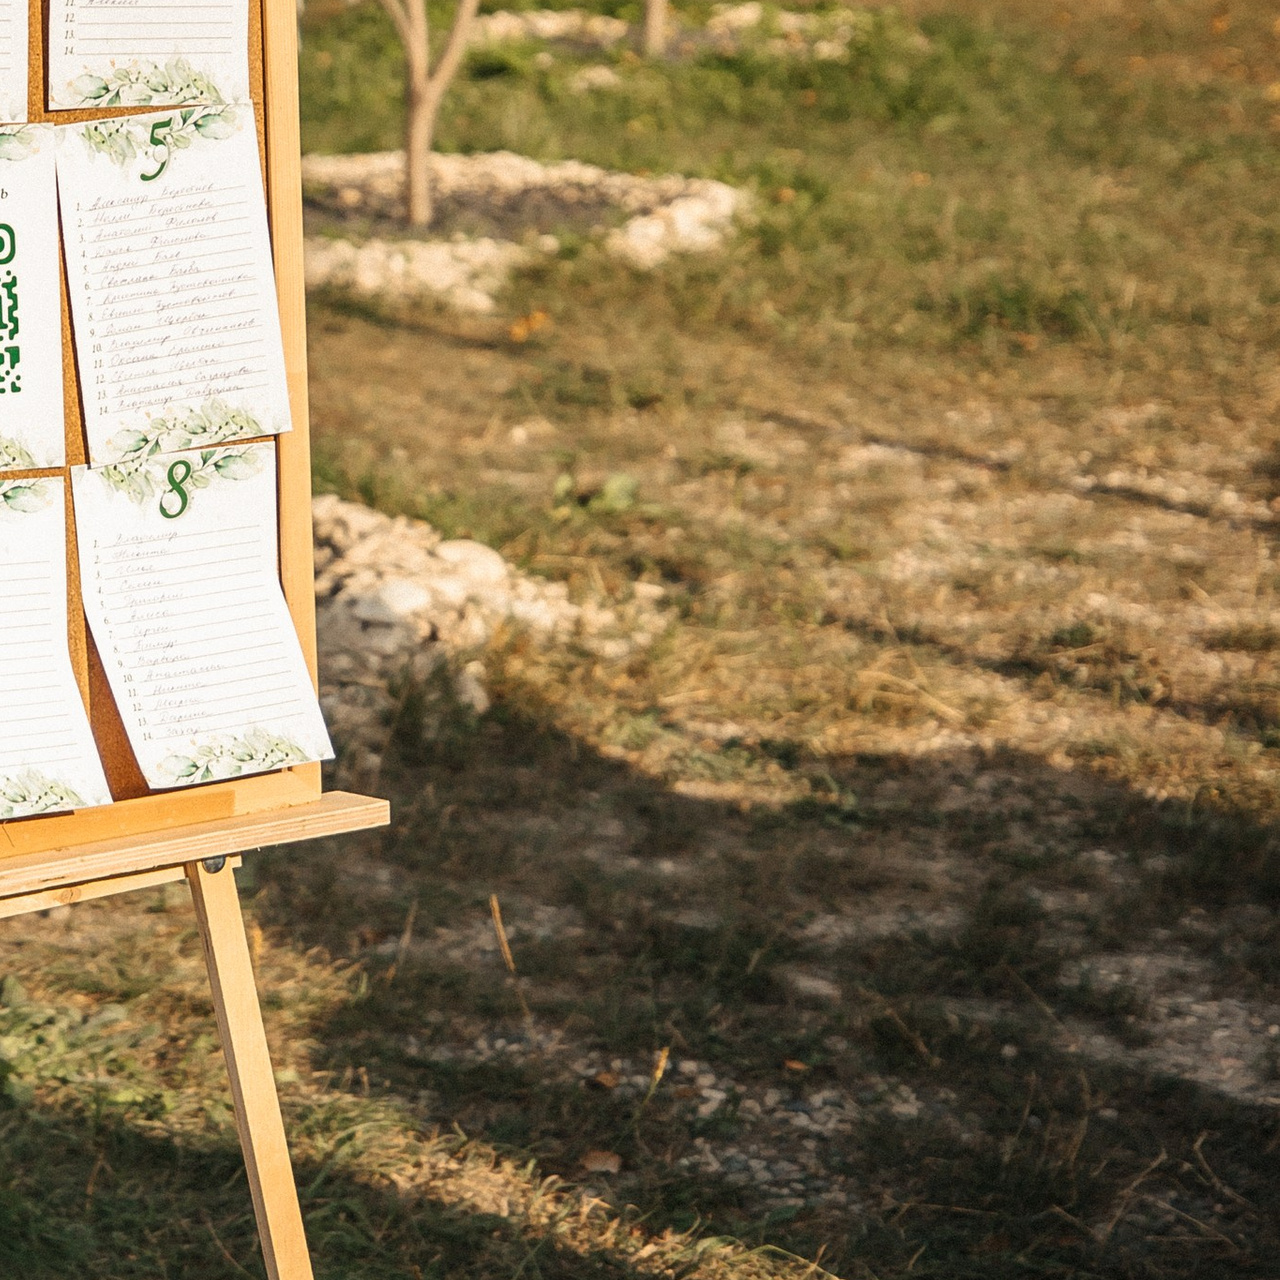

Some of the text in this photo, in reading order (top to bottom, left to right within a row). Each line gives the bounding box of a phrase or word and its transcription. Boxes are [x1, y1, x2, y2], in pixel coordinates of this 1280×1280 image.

[65, 13, 76, 22] 12.
[65, 30, 76, 39] 13.
[65, 47, 76, 56] 14.
[140, 117, 173, 182] 5
[159, 460, 192, 519] 8
